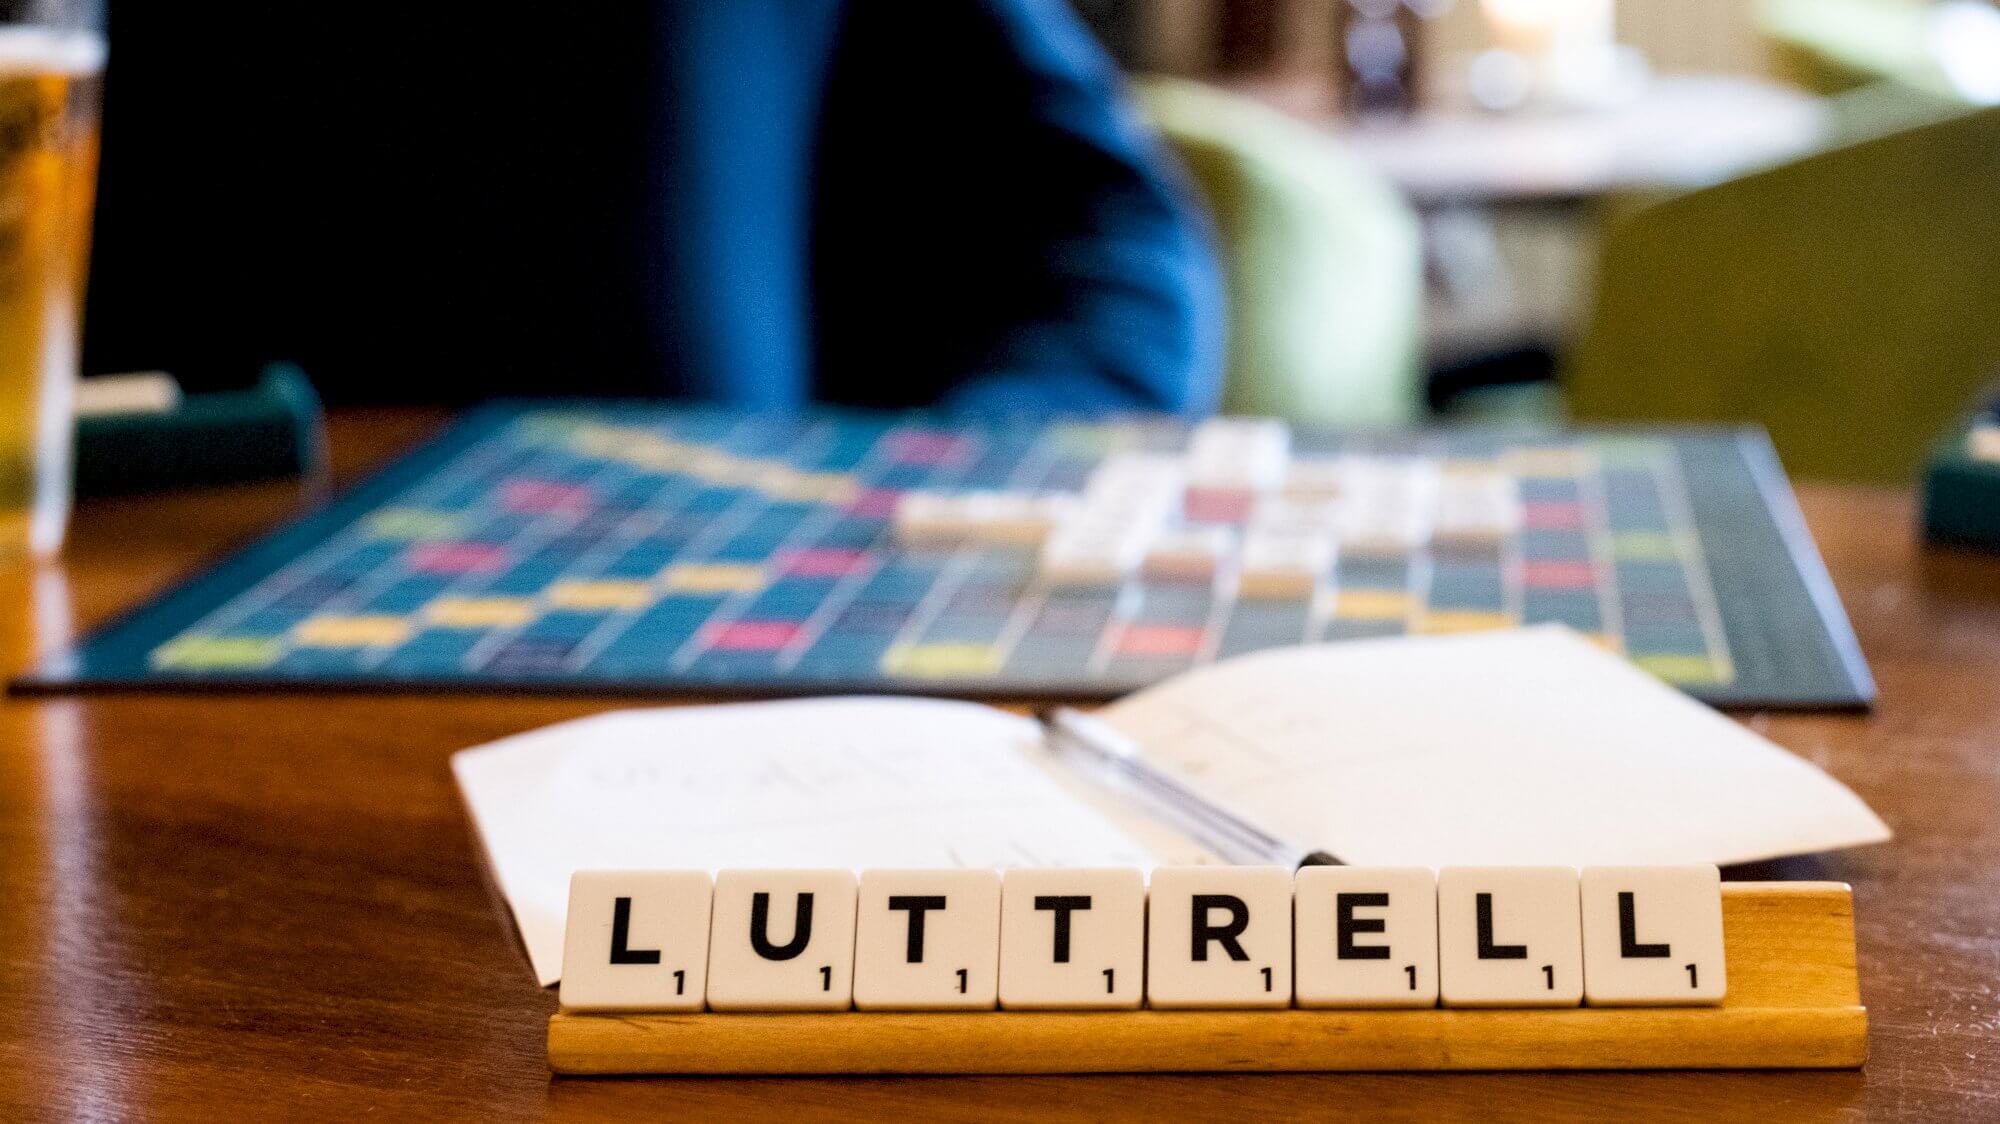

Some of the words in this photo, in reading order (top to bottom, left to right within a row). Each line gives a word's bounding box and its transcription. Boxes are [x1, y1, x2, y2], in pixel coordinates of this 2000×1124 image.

[609, 891, 1672, 965] LUTTRELL
[673, 969, 685, 996] 1
[819, 965, 832, 992] 1
[956, 968, 968, 994] 1
[1102, 968, 1114, 994] 1
[1260, 967, 1272, 992] 1
[1404, 965, 1417, 991] 1
[1541, 965, 1554, 990] 1
[1685, 963, 1698, 989] 1
